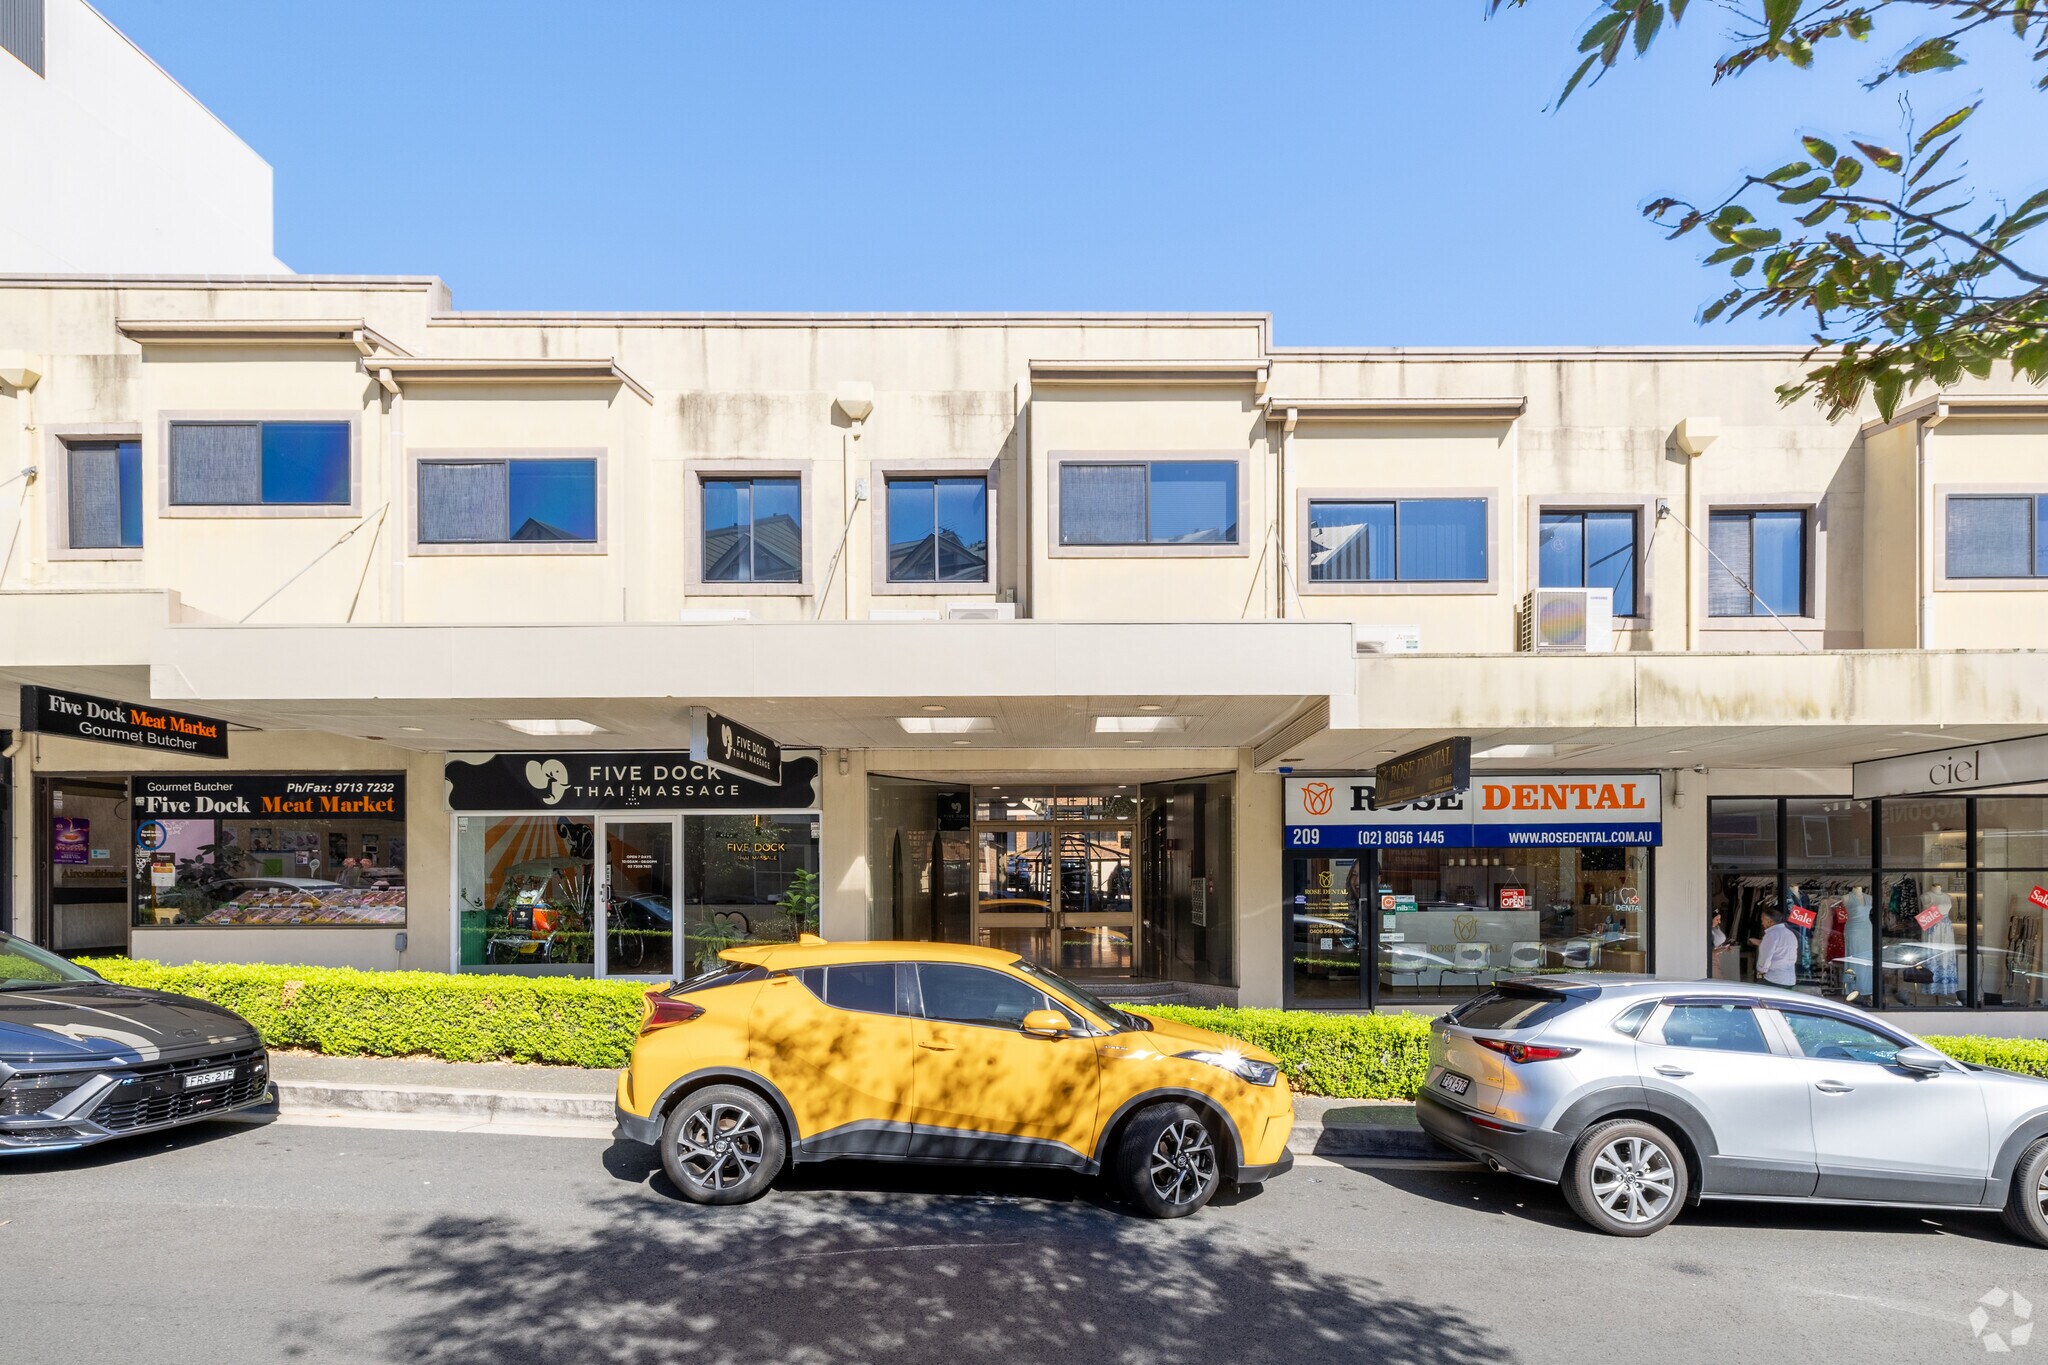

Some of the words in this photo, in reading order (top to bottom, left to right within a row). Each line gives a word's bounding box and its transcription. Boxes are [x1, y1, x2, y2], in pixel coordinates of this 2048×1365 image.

[49, 694, 82, 716] Five
[87, 701, 127, 724] Dock
[130, 709, 166, 730] Meat
[170, 716, 217, 738] Market
[79, 721, 143, 743] Gourmet
[147, 732, 197, 750] Butcher
[733, 748, 746, 760] THAI
[736, 736, 751, 750] FIVE
[752, 742, 766, 758] DOCK
[1391, 760, 1416, 782] ROSE
[1417, 746, 1452, 775] DENTAL
[1929, 750, 1979, 785] ciel
[590, 766, 642, 781] FIVE
[653, 765, 721, 780] DOCK
[147, 782, 192, 792] Gourmet
[194, 782, 234, 791] Butcher
[286, 783, 332, 792] Ph/Fax:
[335, 783, 363, 792] 9713
[366, 783, 395, 792] 7232
[574, 786, 624, 797] THAI
[639, 785, 739, 796] MASSAGE
[145, 796, 191, 813] Five
[195, 796, 251, 813] Dock
[260, 796, 314, 813] Meat
[318, 795, 396, 813] Market
[1482, 784, 1645, 811] DENTAL
[1293, 828, 1320, 845] 209
[1358, 831, 1382, 845] (02)
[1385, 831, 1414, 844] 8056
[1417, 831, 1444, 844] 1445
[1508, 831, 1652, 844] WWW.ROSEDENTAL.COM.AU
[727, 844, 750, 852] FIVE
[754, 843, 785, 852] DOCK
[1502, 898, 1524, 906] OPEN
[1790, 908, 1812, 925] Sale
[1918, 910, 1940, 927] Sale
